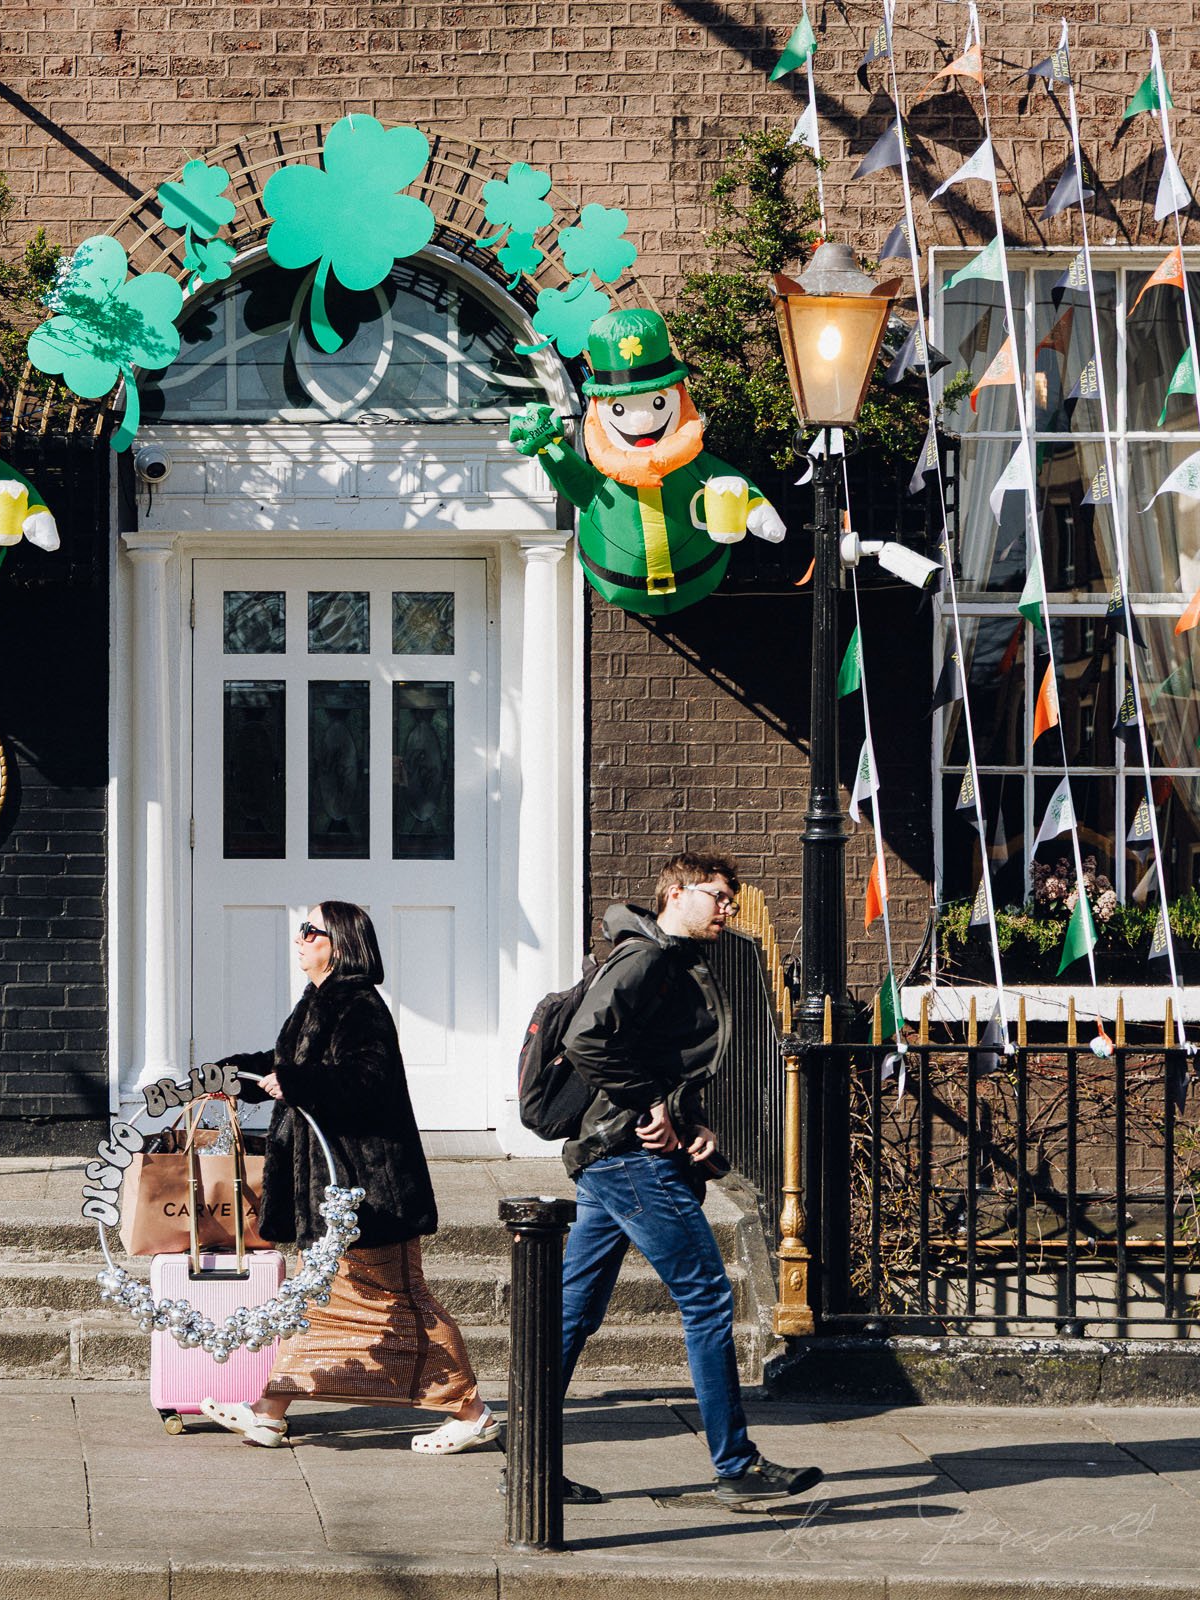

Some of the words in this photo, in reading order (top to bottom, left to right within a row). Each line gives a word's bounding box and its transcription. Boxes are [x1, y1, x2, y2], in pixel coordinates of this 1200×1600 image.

[142, 1063, 241, 1117] BRIDE
[82, 1122, 145, 1227] DISCO
[163, 1203, 259, 1217] CARVEA
